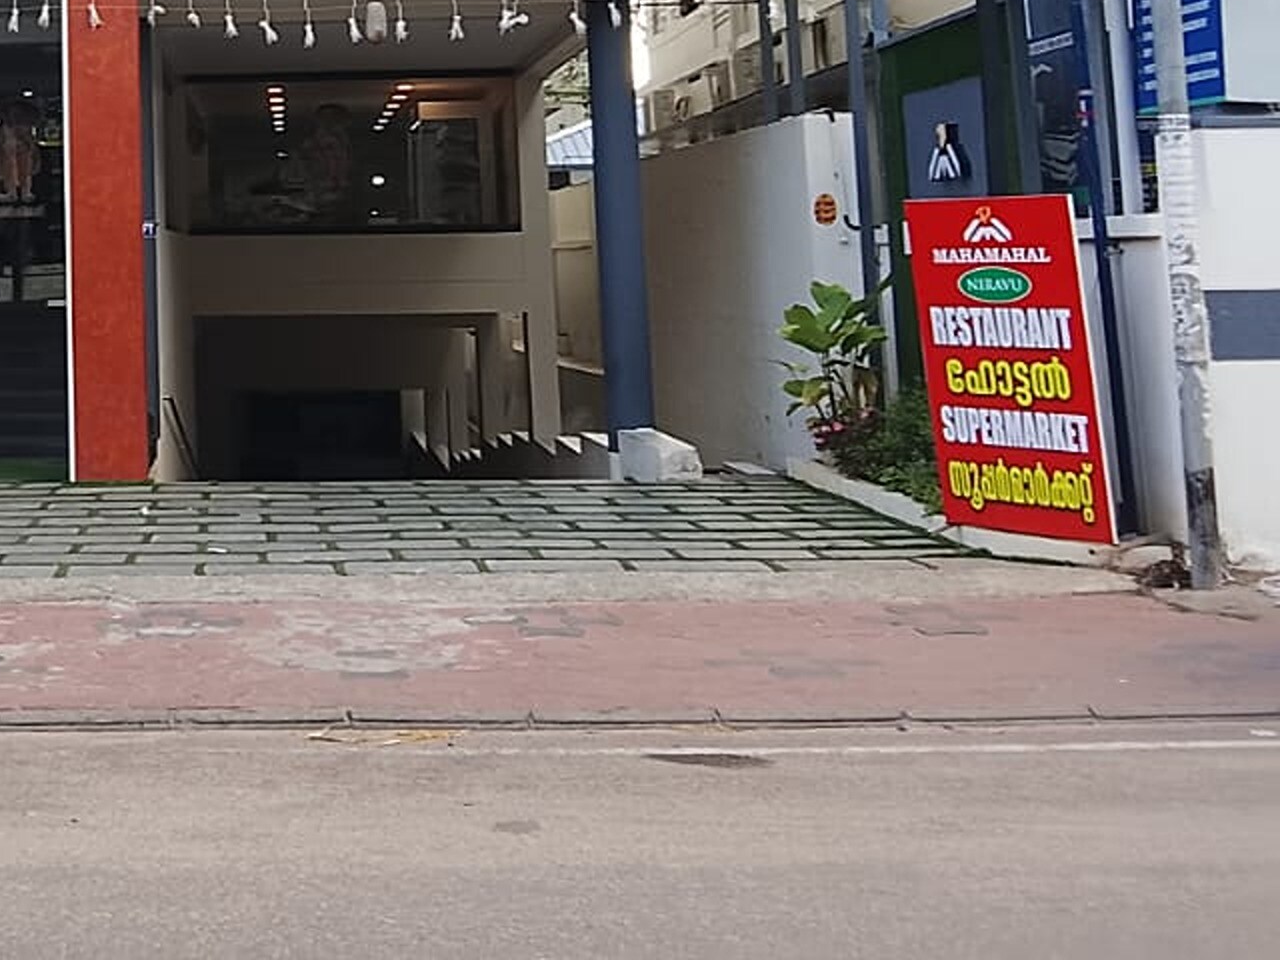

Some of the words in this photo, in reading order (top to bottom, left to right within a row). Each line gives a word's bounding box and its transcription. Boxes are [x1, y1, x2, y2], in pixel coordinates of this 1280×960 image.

[932, 247, 1052, 264] MAHAMAHAL
[966, 277, 1023, 292] NIRAVU
[929, 305, 1072, 350] RESTAURANT
[940, 404, 1089, 454] SUPERMARKET
